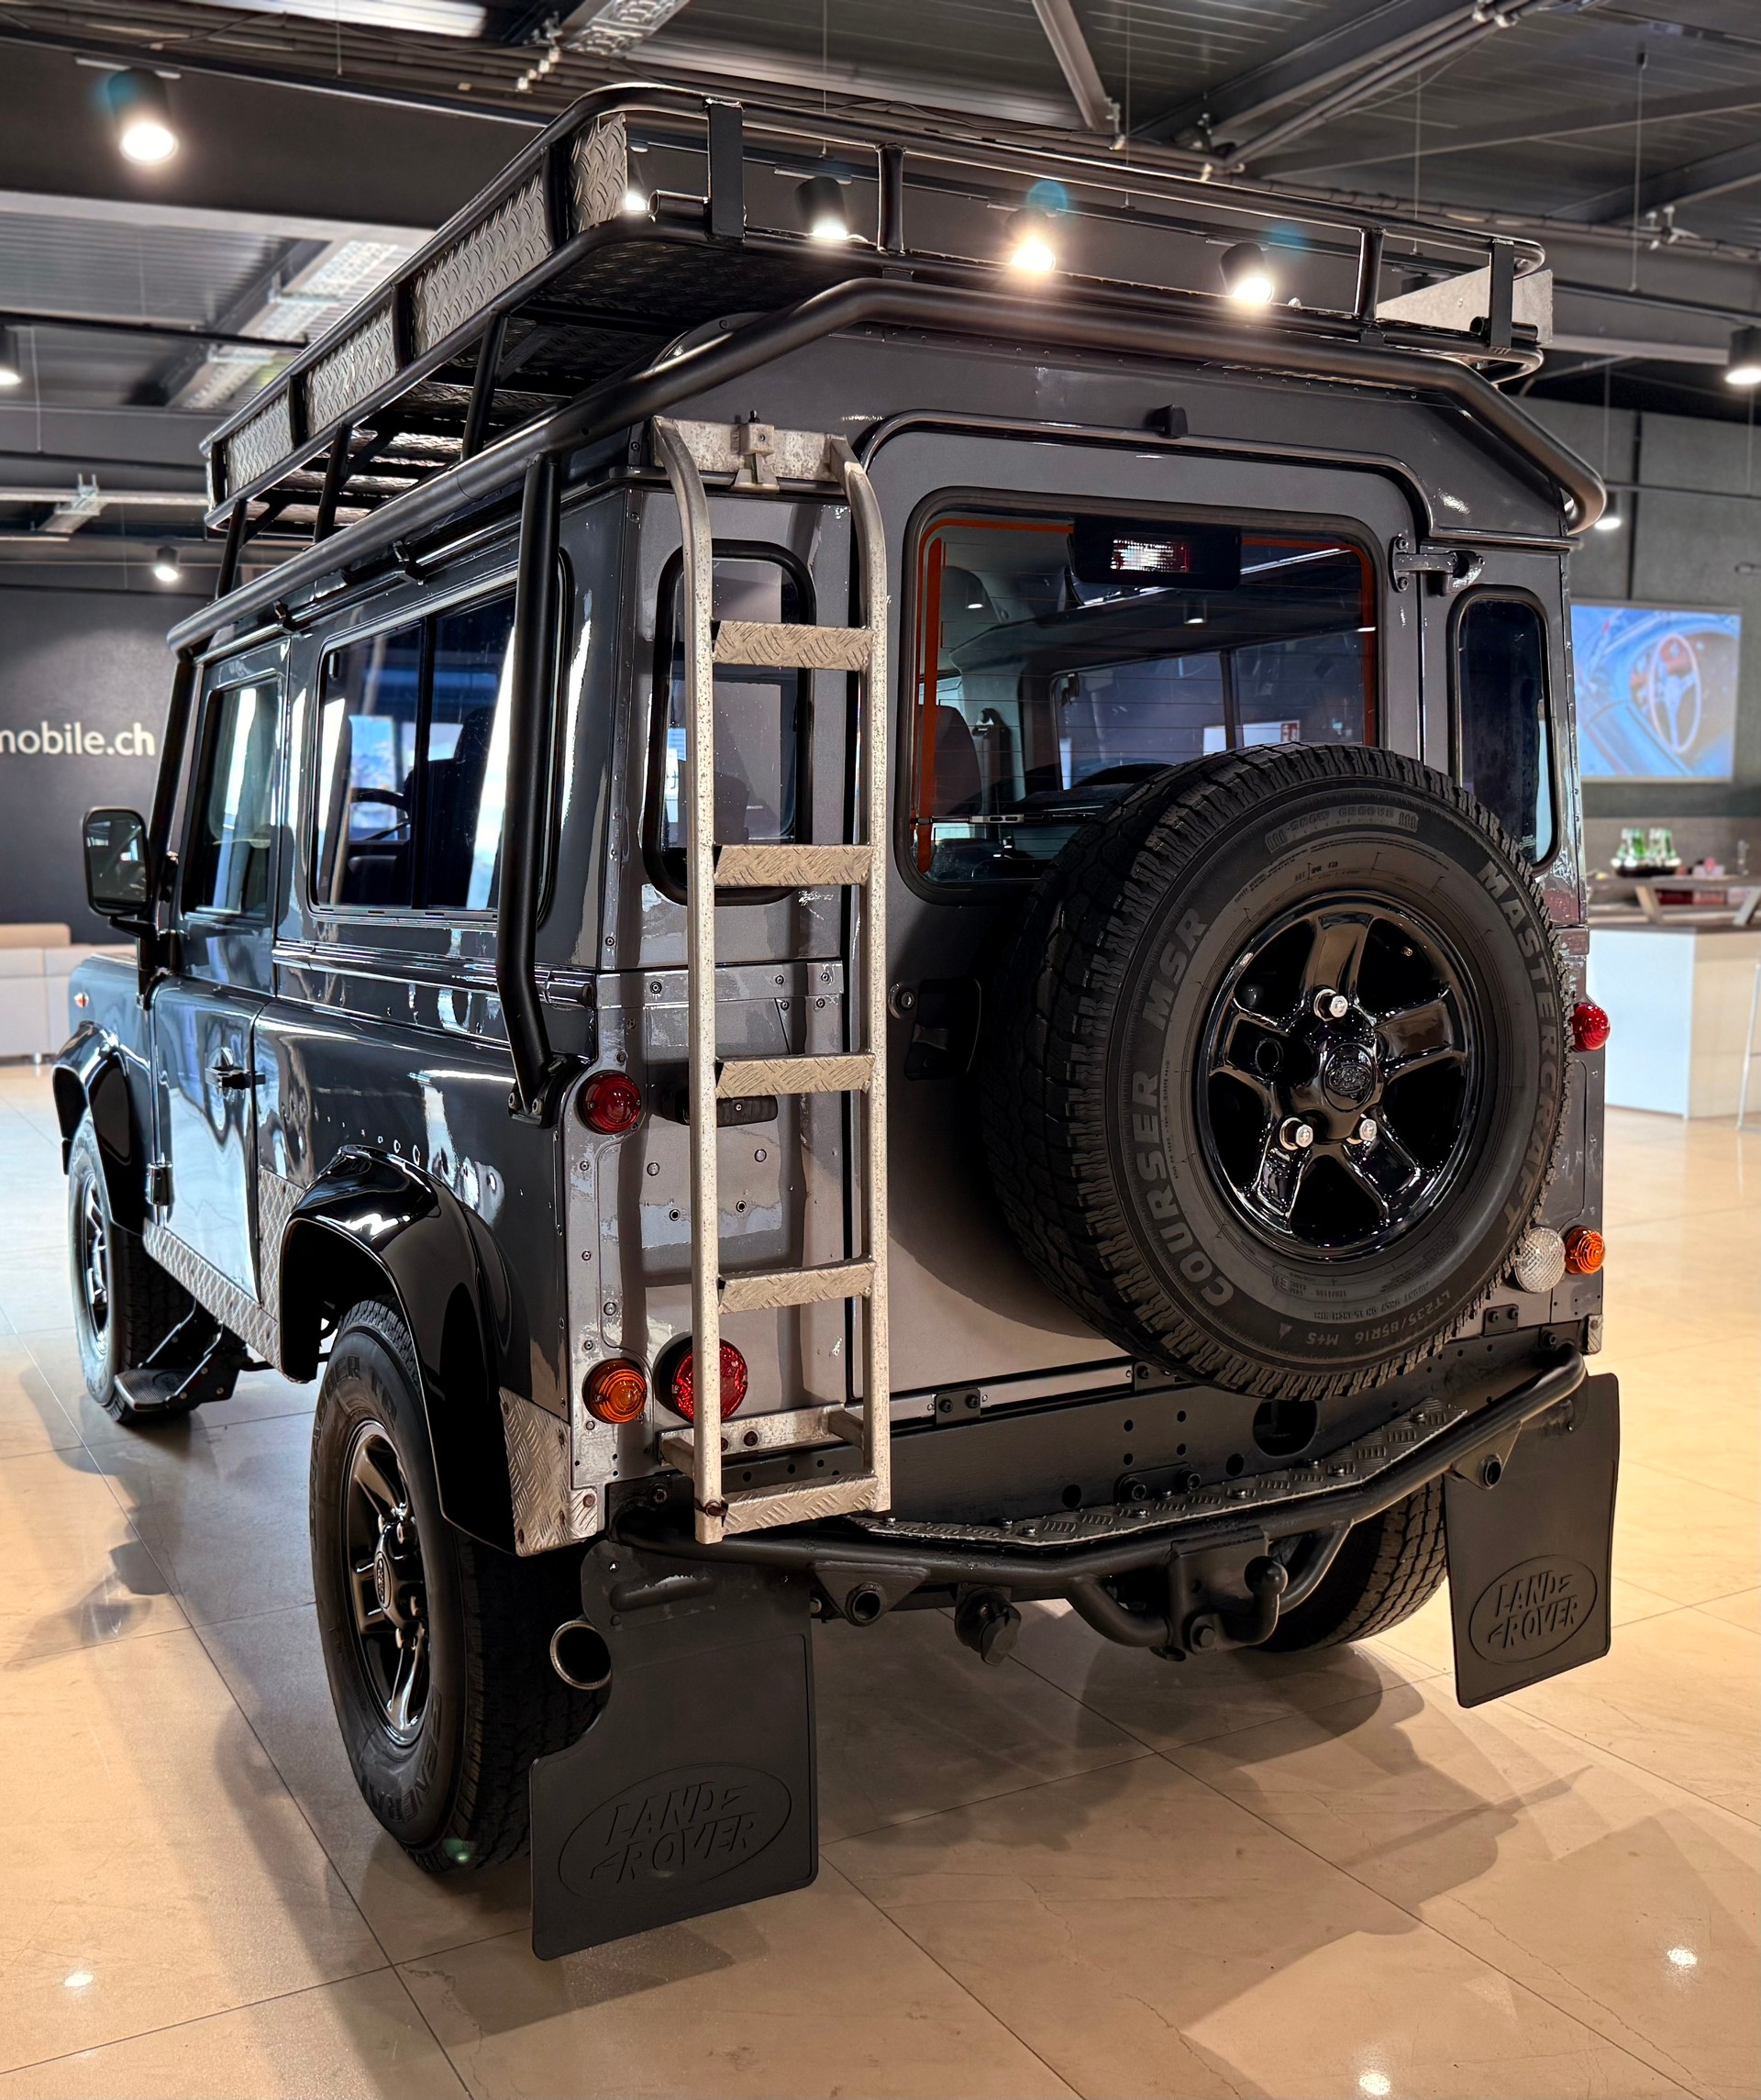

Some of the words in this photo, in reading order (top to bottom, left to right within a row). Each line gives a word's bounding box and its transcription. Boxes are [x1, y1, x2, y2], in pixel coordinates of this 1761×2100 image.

[1144, 906, 1211, 1032] MSR
[1476, 859, 1558, 1236] MASTERCRAFT
[1132, 1070, 1234, 1307] COURSER
[1355, 1289, 1452, 1345] LT235/85R16
[1496, 1569, 1556, 1617] LAND
[1502, 1594, 1578, 1650] ROVER
[605, 1781, 715, 1846] LAND
[615, 1812, 756, 1883] ROVER
